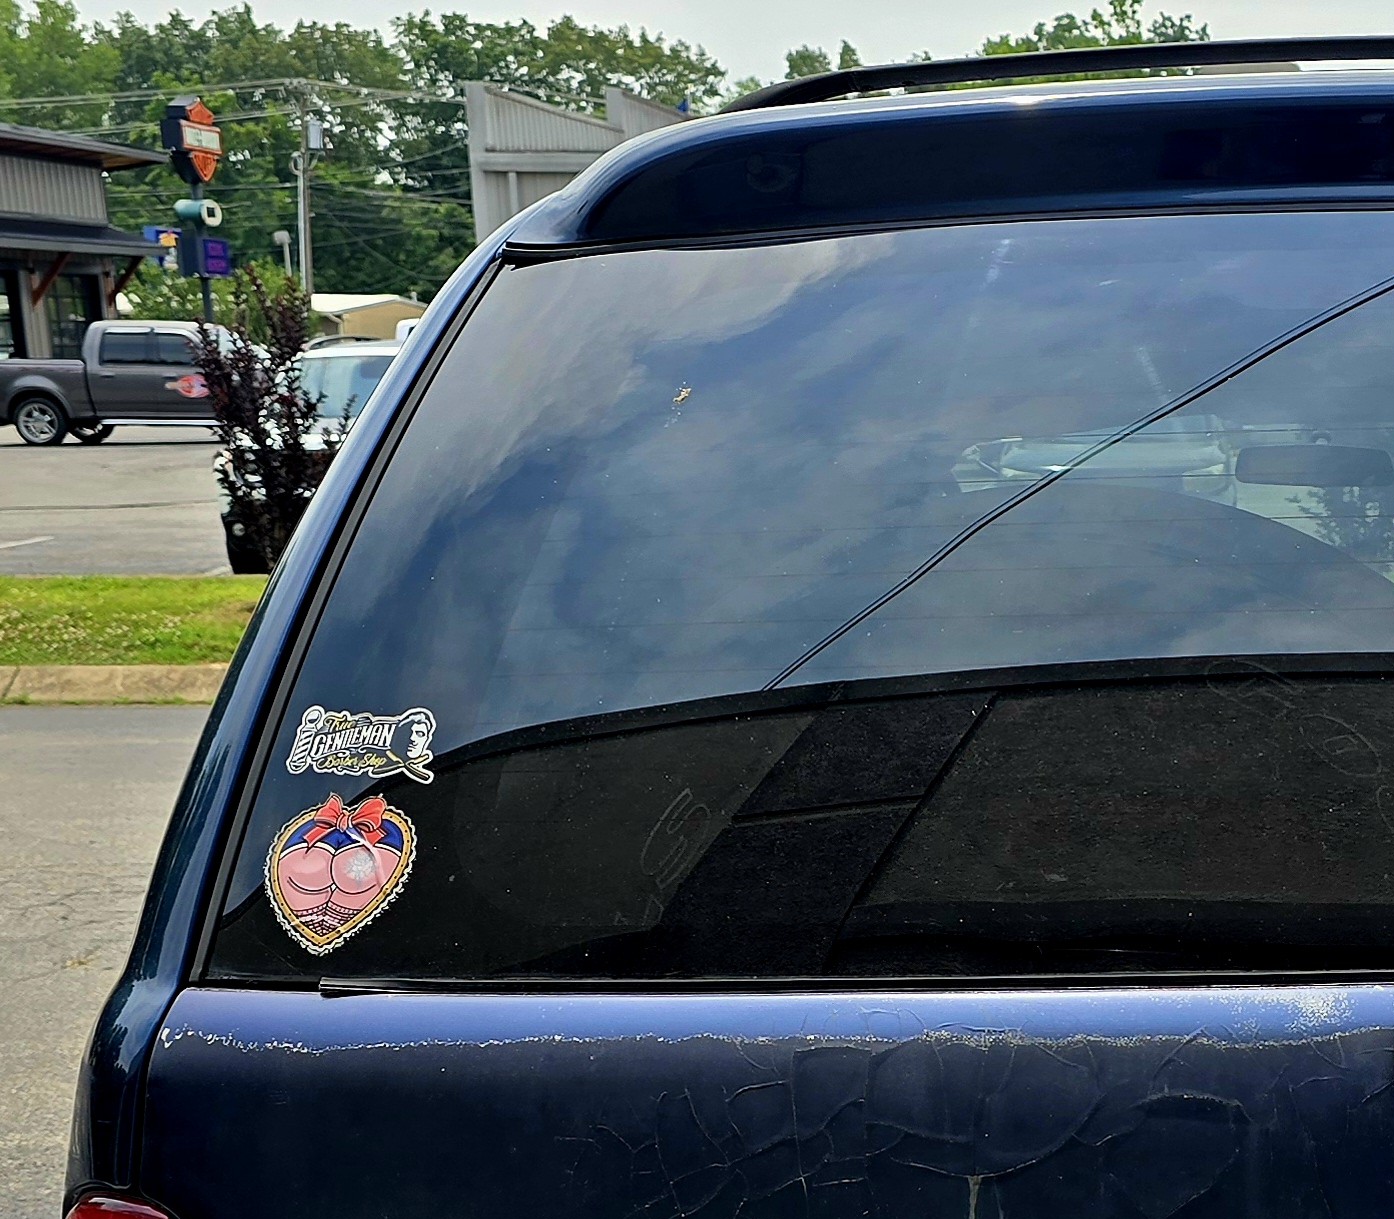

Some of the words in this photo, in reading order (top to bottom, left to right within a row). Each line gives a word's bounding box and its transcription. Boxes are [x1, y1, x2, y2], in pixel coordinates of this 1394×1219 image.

[324, 714, 356, 732] True
[311, 723, 397, 757] GENTLEMAN
[318, 753, 359, 769] Barber
[359, 753, 387, 769] Shop
